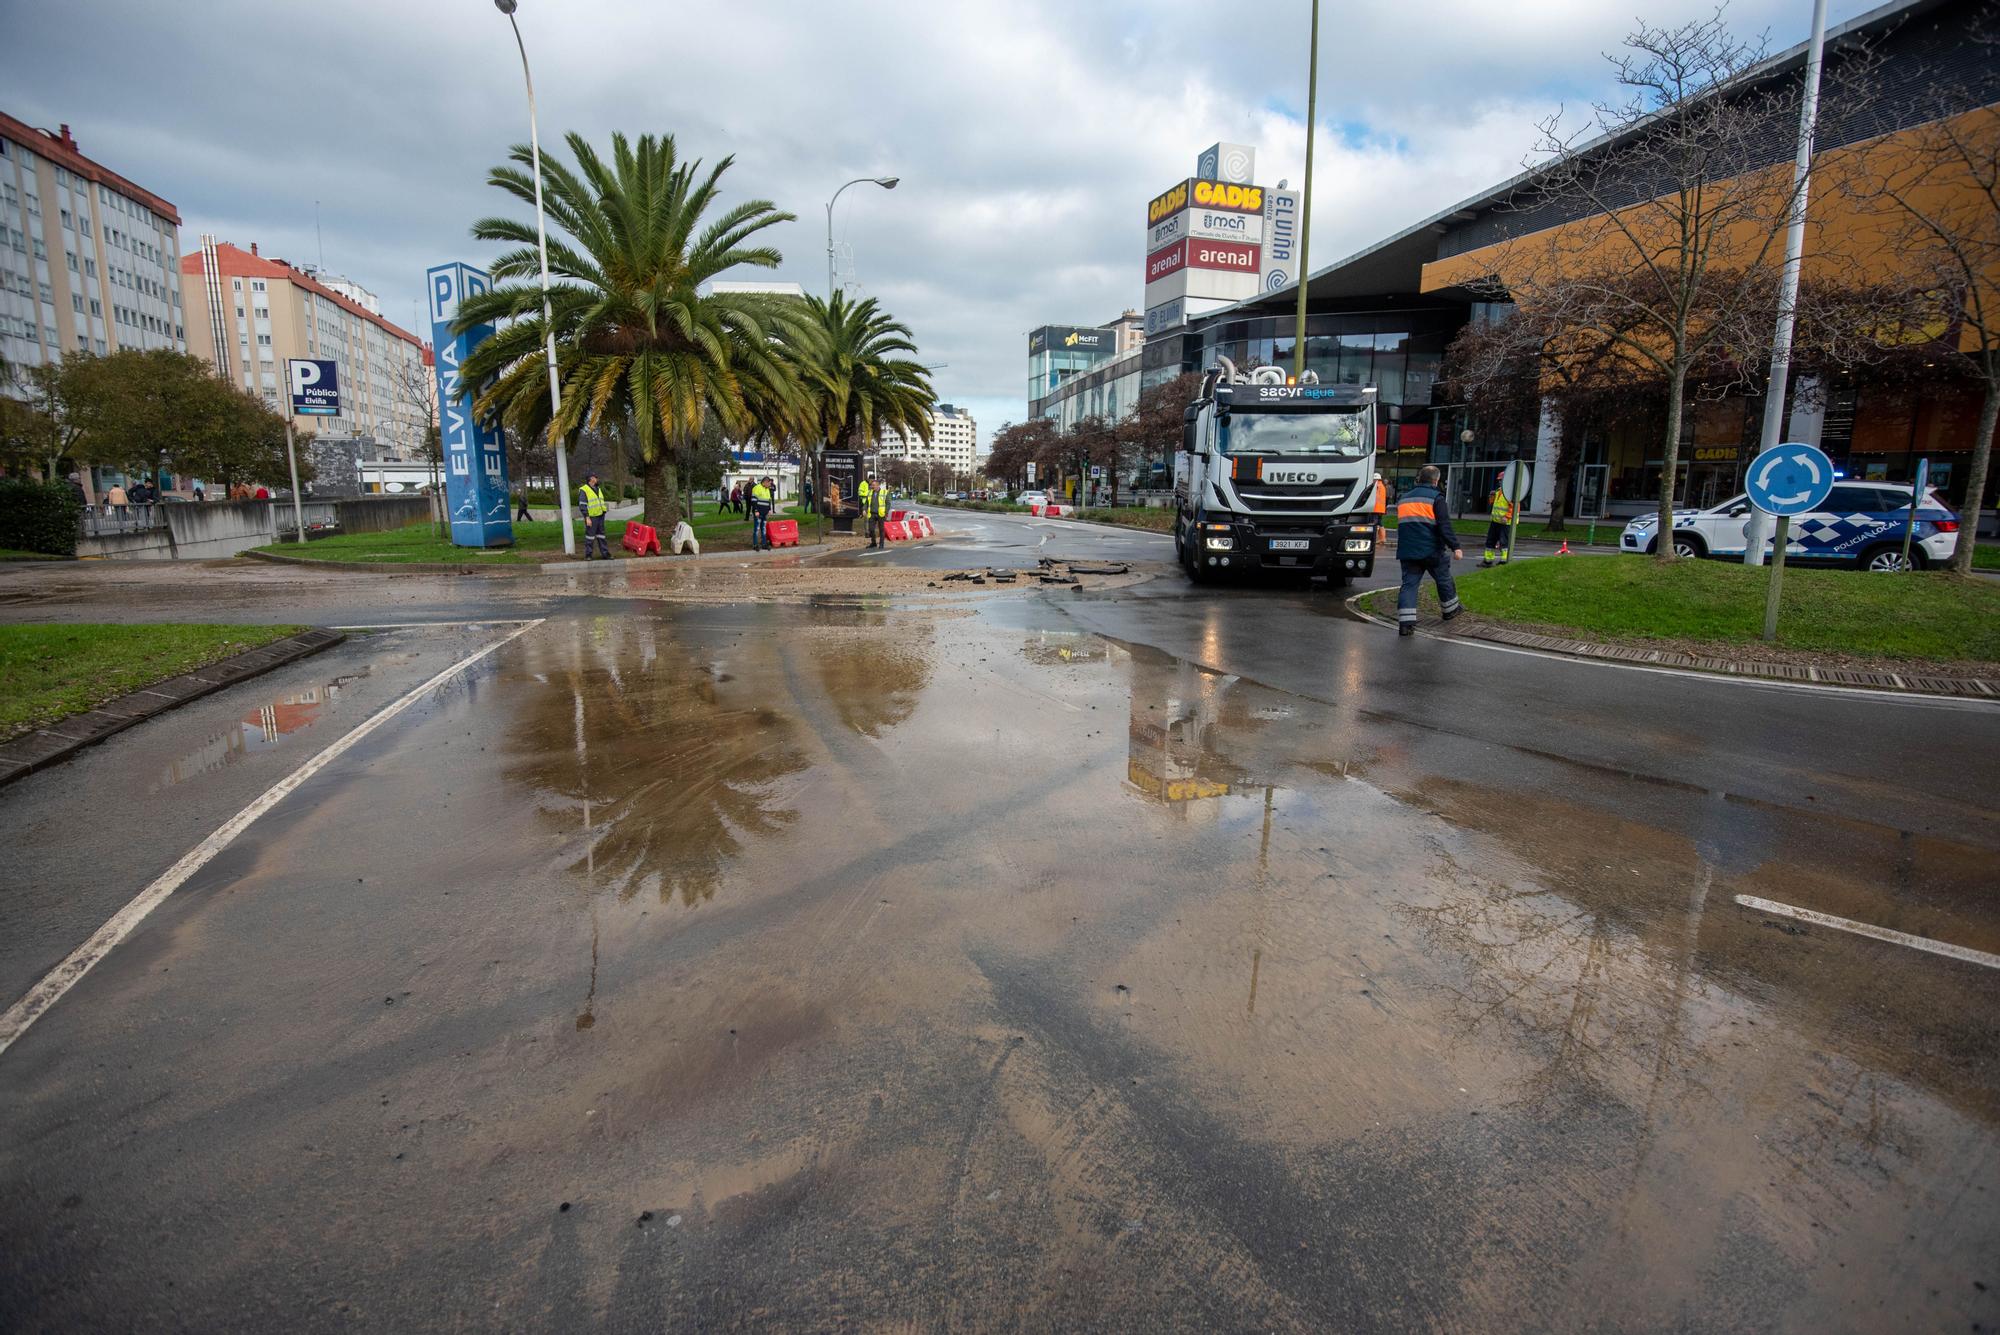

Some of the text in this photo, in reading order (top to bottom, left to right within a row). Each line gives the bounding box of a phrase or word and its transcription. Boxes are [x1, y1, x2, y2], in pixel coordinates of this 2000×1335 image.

[1150, 183, 1187, 222] GADIS
[1194, 181, 1262, 211] GADIS
[1151, 247, 1181, 276] arenal
[1199, 249, 1253, 267] arenal
[435, 274, 453, 318] P
[1078, 335, 1099, 343] McFIT
[290, 360, 321, 396] P
[304, 397, 327, 405] Elviña
[306, 387, 338, 397] Público
[1260, 387, 1335, 400] sacyr agua
[439, 340, 469, 476] ELVIÑA
[1695, 447, 1738, 460] GADIS
[1269, 472, 1318, 483] IVECO
[1832, 519, 1902, 553] POLICÍA LOCAL
